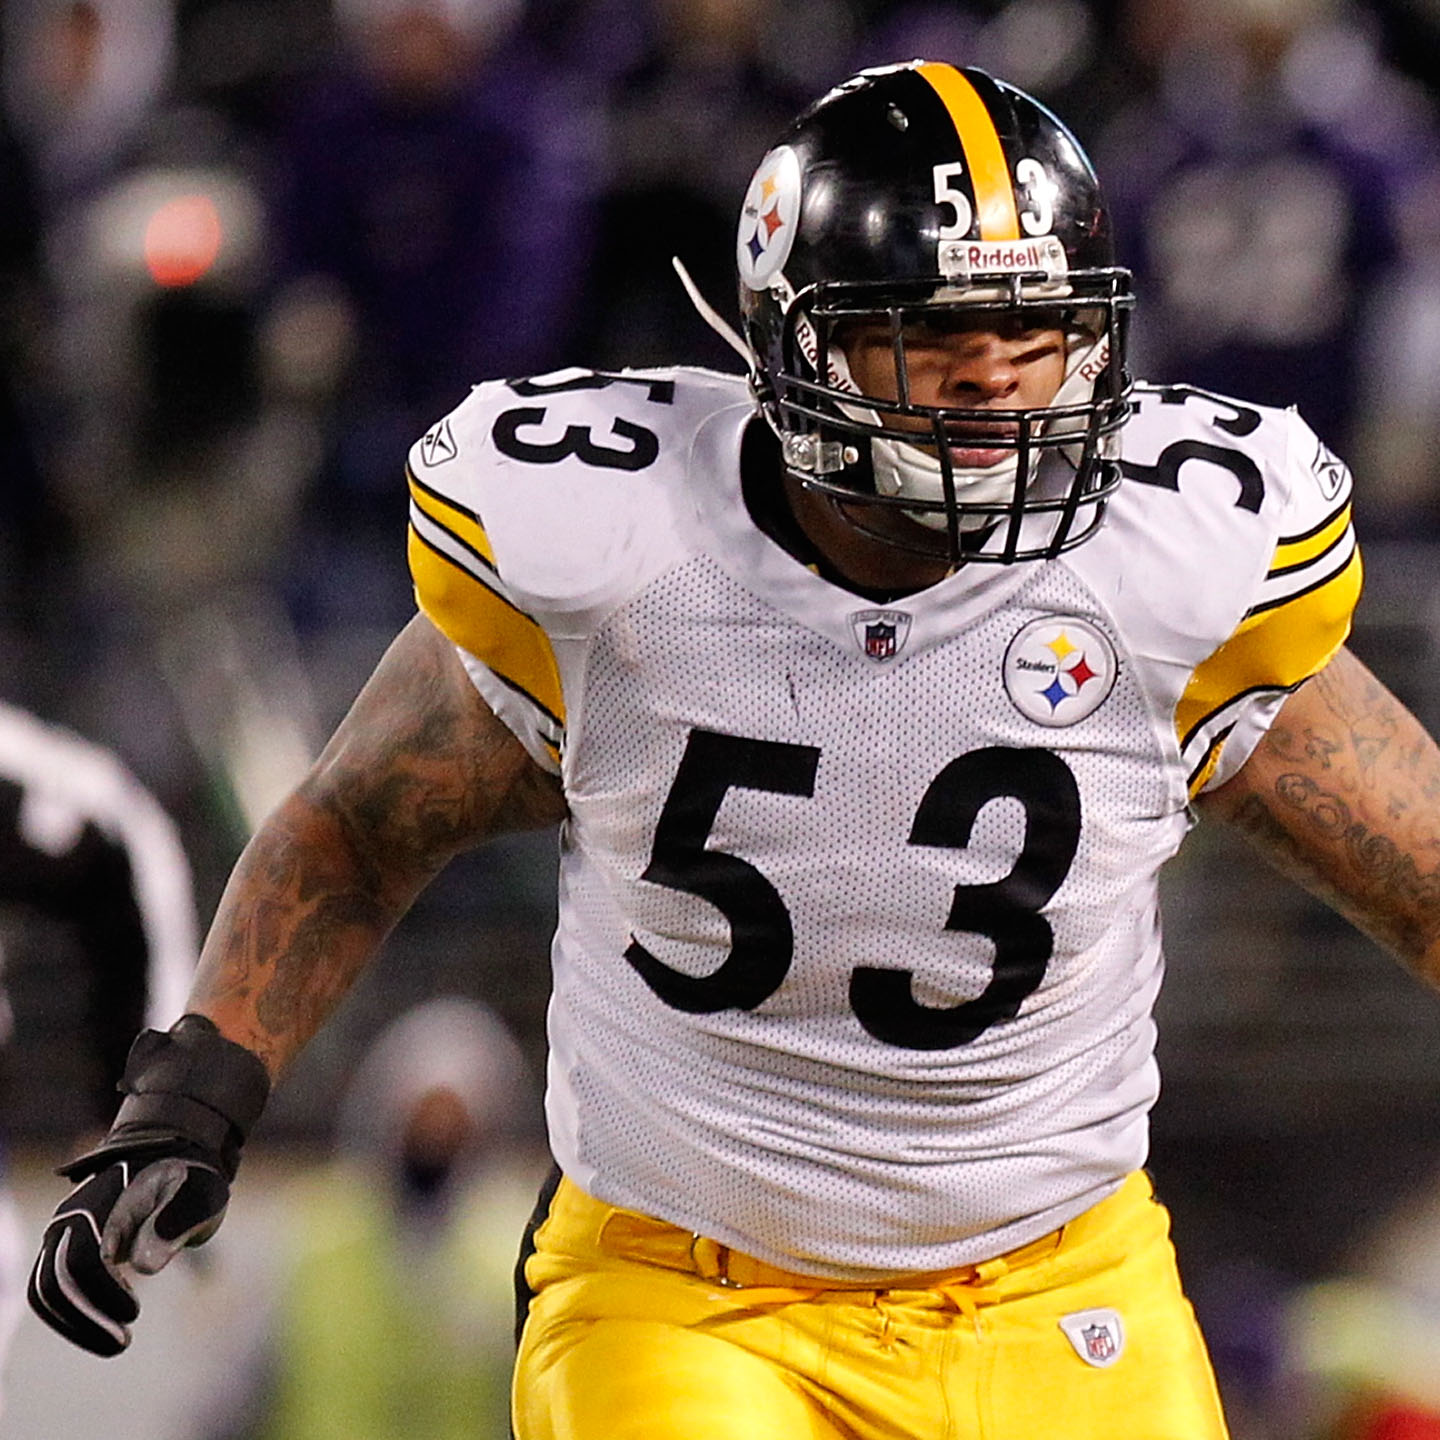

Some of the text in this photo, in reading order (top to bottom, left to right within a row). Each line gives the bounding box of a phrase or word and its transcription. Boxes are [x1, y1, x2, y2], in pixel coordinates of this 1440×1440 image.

[933, 158, 1058, 240] 53
[968, 246, 1039, 268] Riddell
[491, 371, 675, 472] 53
[1016, 658, 1055, 674] Steelers
[623, 729, 1081, 1050] 53
